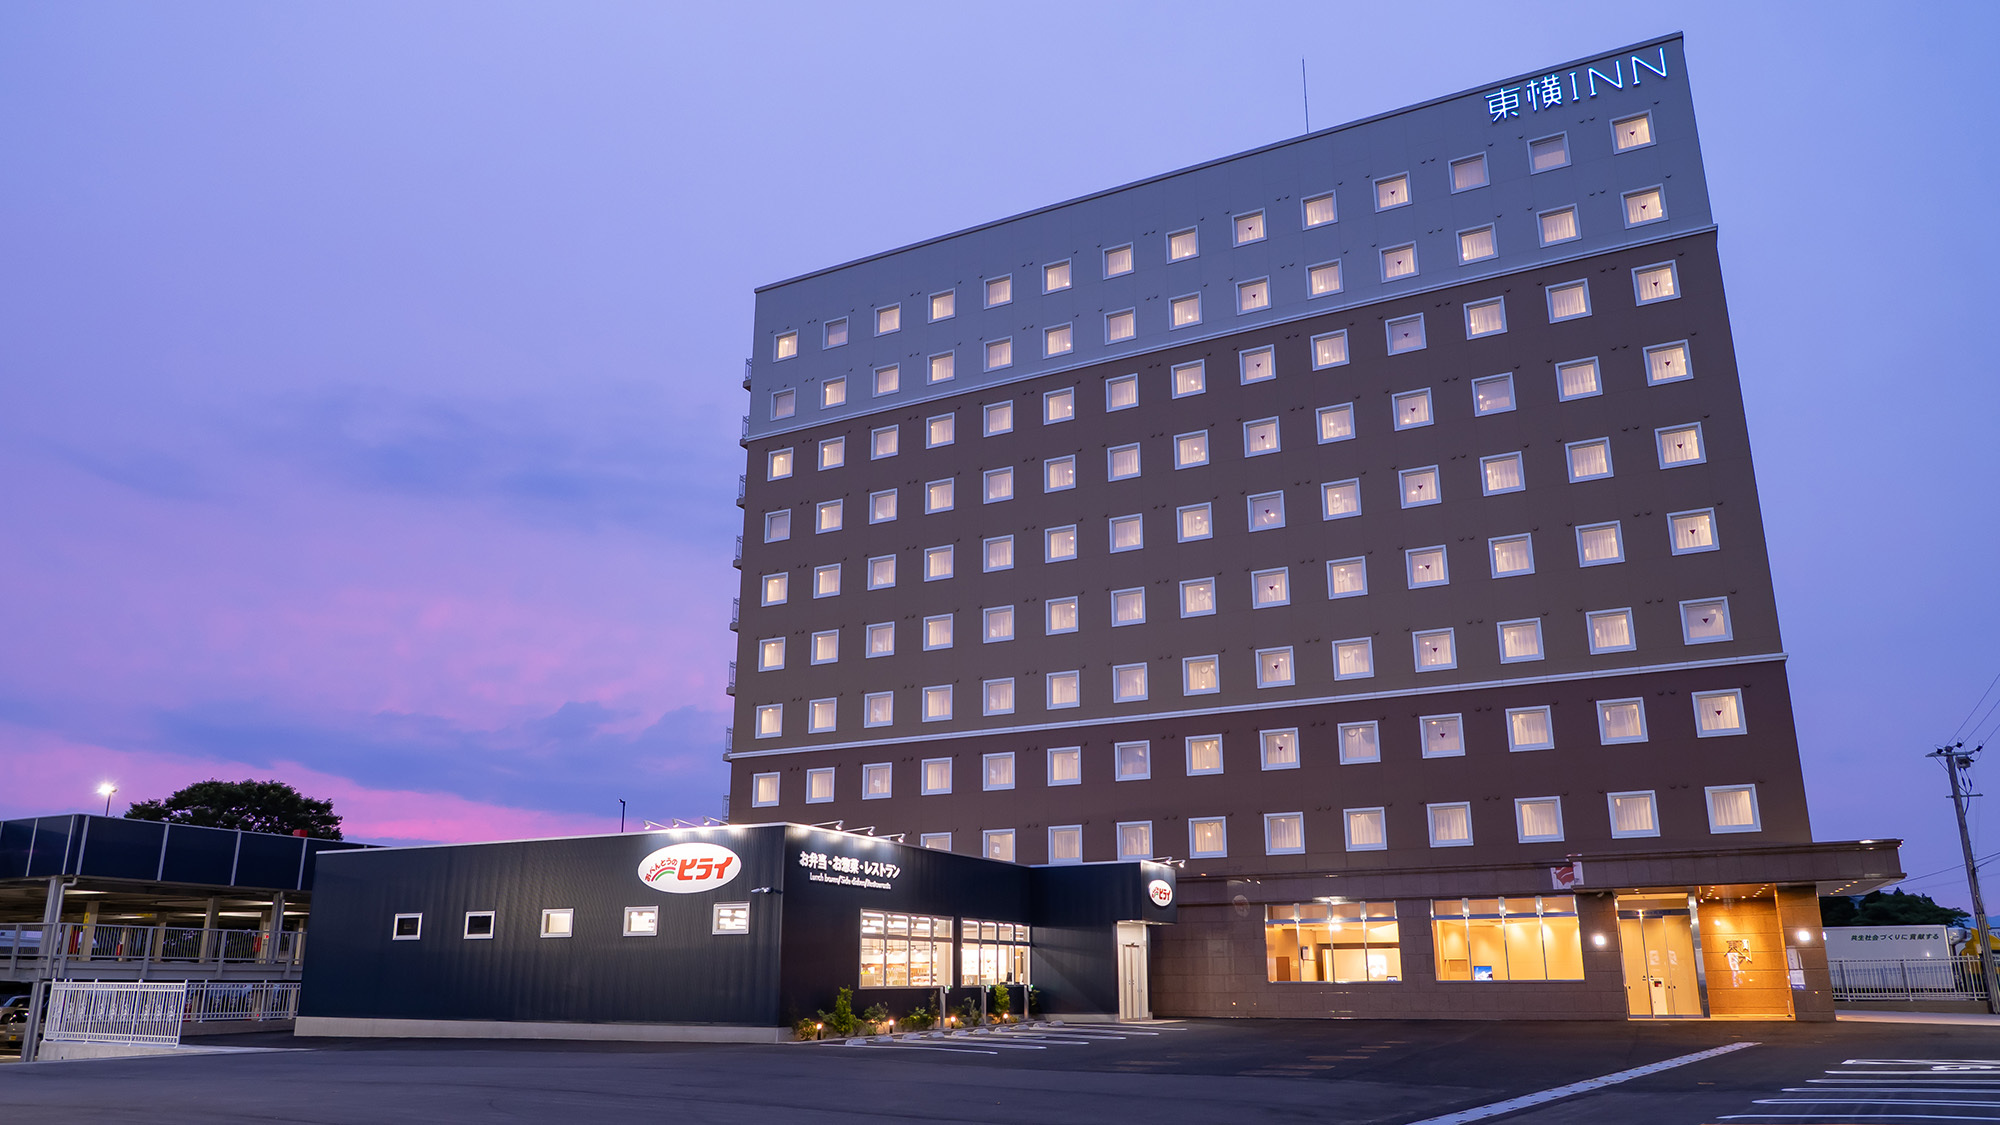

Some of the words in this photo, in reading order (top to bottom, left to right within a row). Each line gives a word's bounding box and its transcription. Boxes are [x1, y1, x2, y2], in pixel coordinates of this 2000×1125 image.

[1484, 47, 1668, 123] 東横INN
[677, 857, 733, 881] ヒライ
